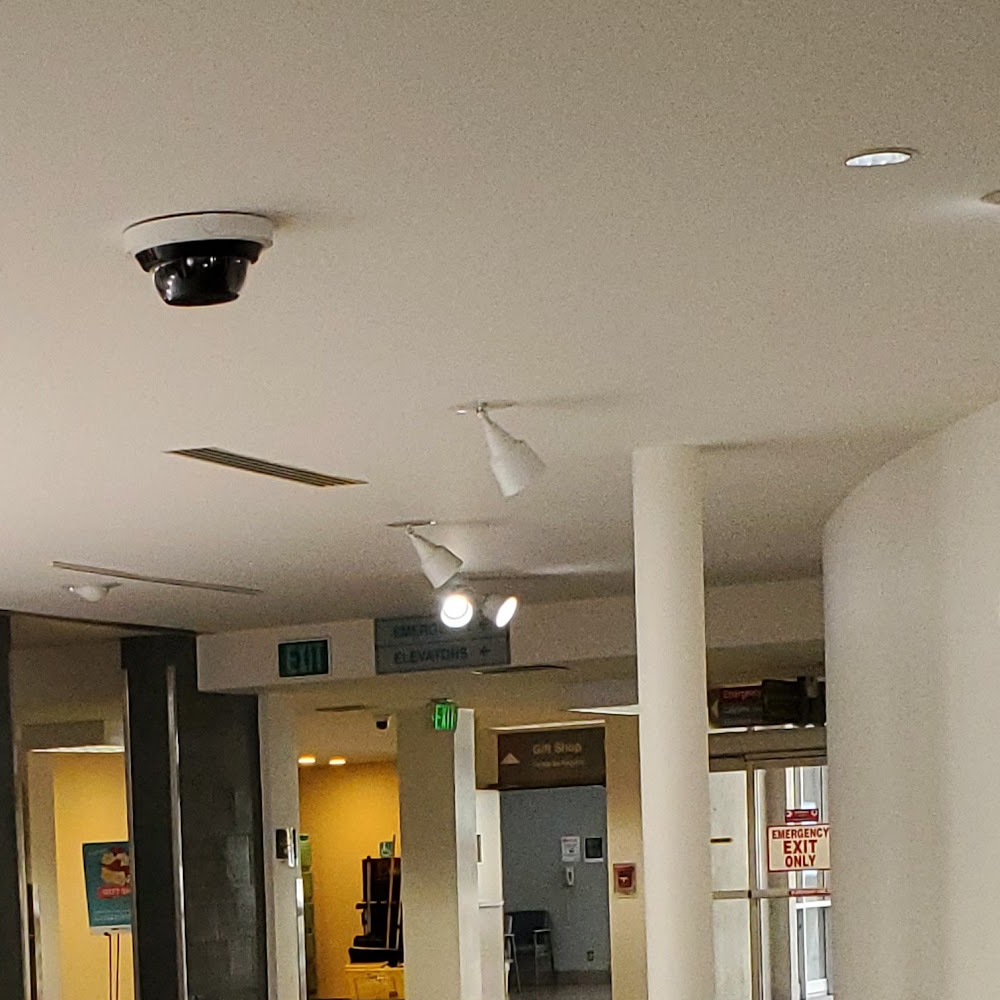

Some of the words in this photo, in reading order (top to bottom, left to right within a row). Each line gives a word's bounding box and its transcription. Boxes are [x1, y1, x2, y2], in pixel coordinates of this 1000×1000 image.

[393, 646, 469, 664] ELEVATORS
[435, 704, 455, 730] EXIT
[772, 827, 829, 839] EMERGENCY
[783, 840, 818, 854] EXIT
[785, 855, 816, 868] ONLY
